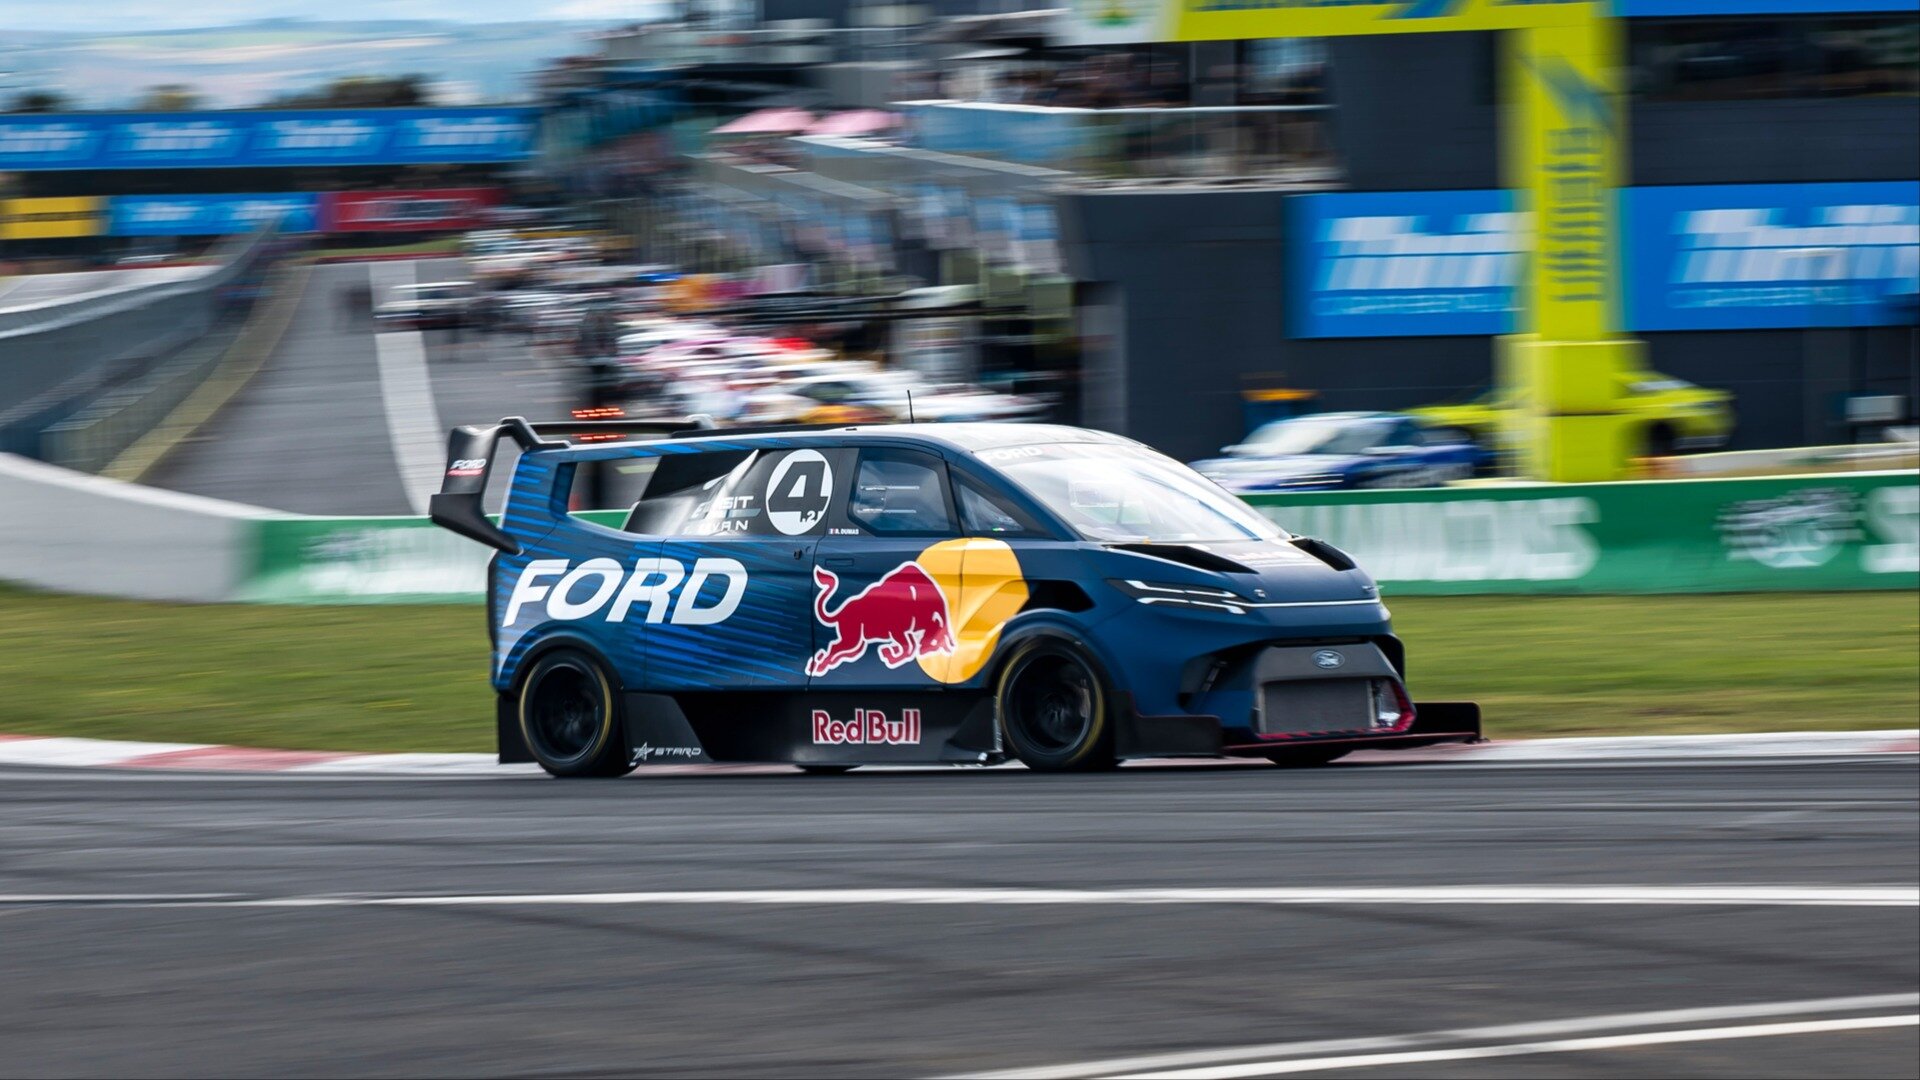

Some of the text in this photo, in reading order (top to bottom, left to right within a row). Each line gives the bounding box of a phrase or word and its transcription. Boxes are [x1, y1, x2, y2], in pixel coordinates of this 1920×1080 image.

[450, 459, 487, 470] FORD
[503, 557, 748, 627] FORD
[812, 708, 920, 745] Red Bull
[654, 747, 702, 758] STARD
